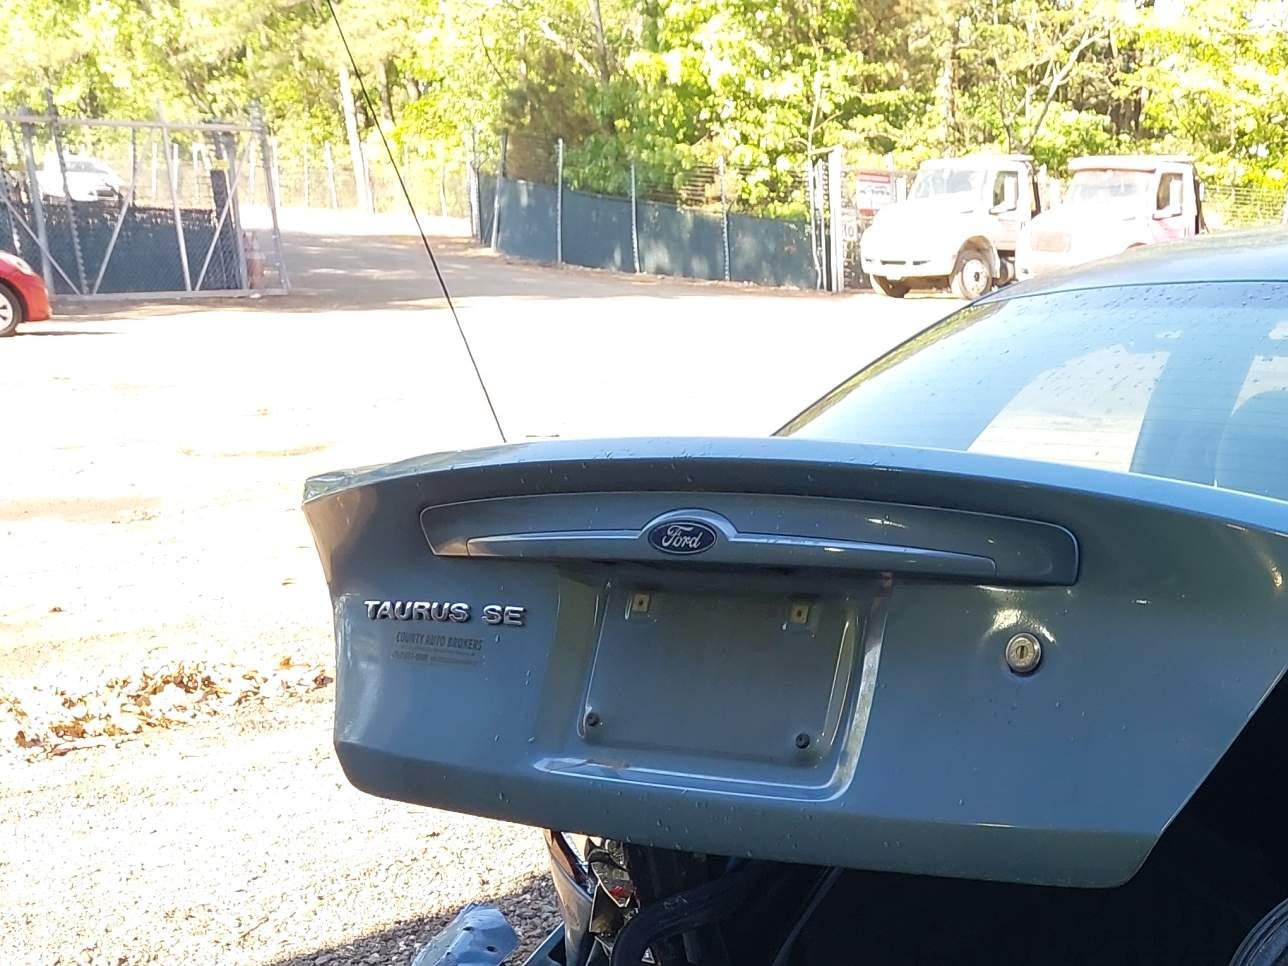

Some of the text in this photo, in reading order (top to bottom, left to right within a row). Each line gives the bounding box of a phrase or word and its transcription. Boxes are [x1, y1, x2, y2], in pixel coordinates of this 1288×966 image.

[661, 525, 704, 548] Ford
[364, 600, 525, 626] TAURUS SE
[425, 634, 446, 647] AUTO
[446, 636, 484, 651] BROKERS
